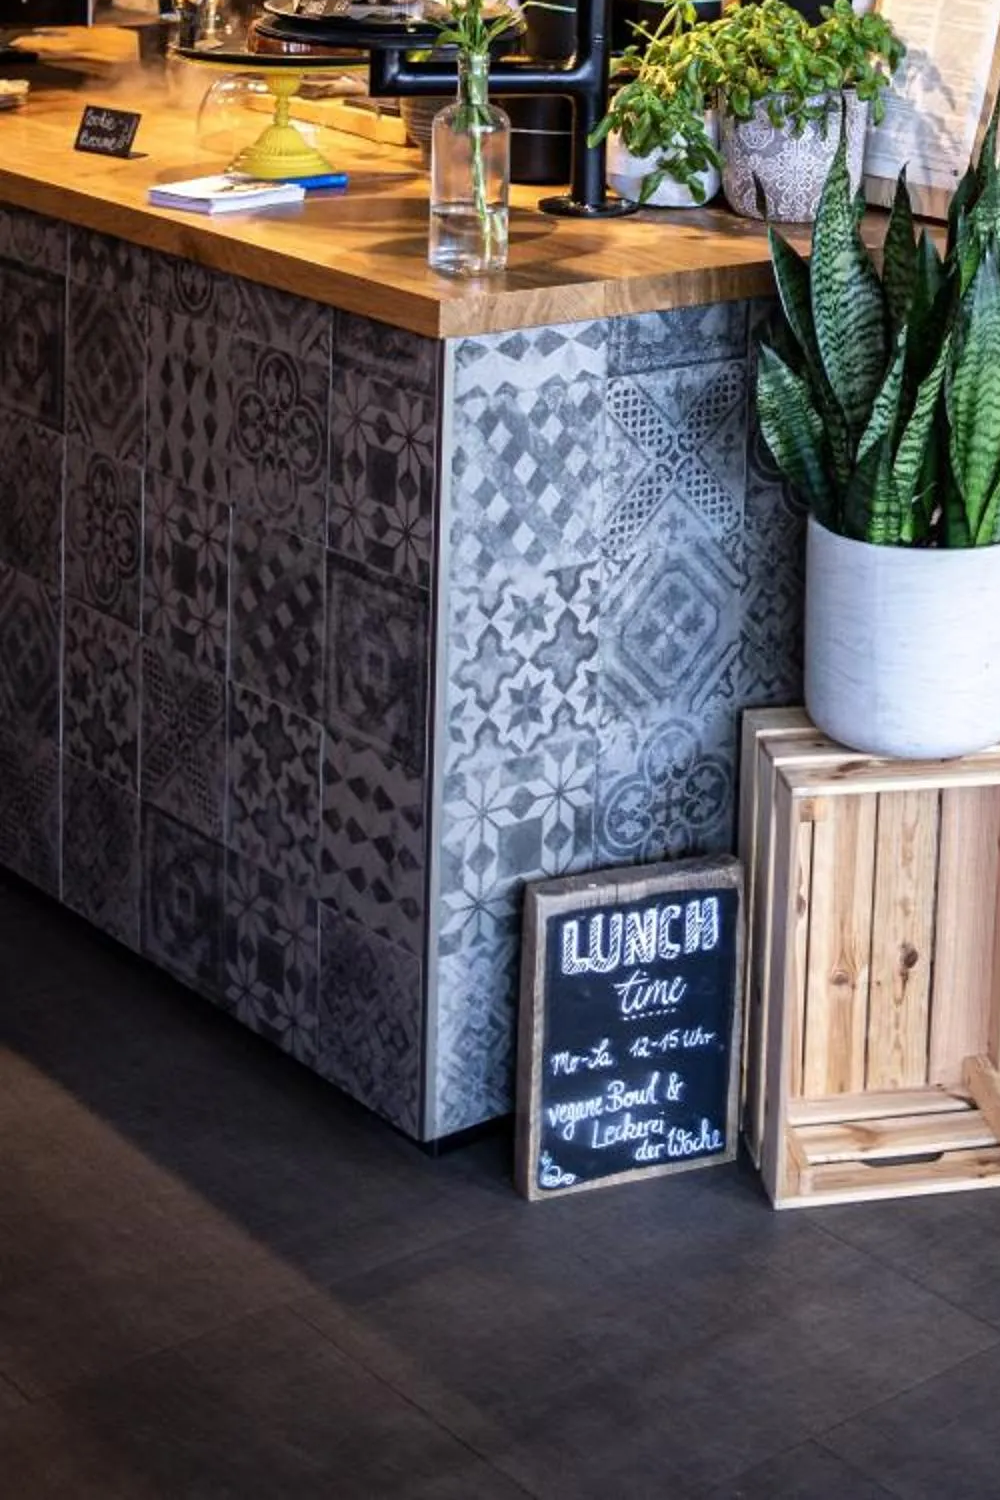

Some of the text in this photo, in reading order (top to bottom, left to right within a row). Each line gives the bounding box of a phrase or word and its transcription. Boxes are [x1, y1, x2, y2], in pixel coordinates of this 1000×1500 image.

[561, 896, 720, 976] LUNCH
[613, 969, 687, 1014] time
[629, 1028, 680, 1058] 12-15
[682, 1026, 715, 1048] Uhr
[547, 1071, 684, 1141] vegane Bowl &
[591, 1111, 666, 1149] Leckerei
[635, 1117, 724, 1161] der Woche
